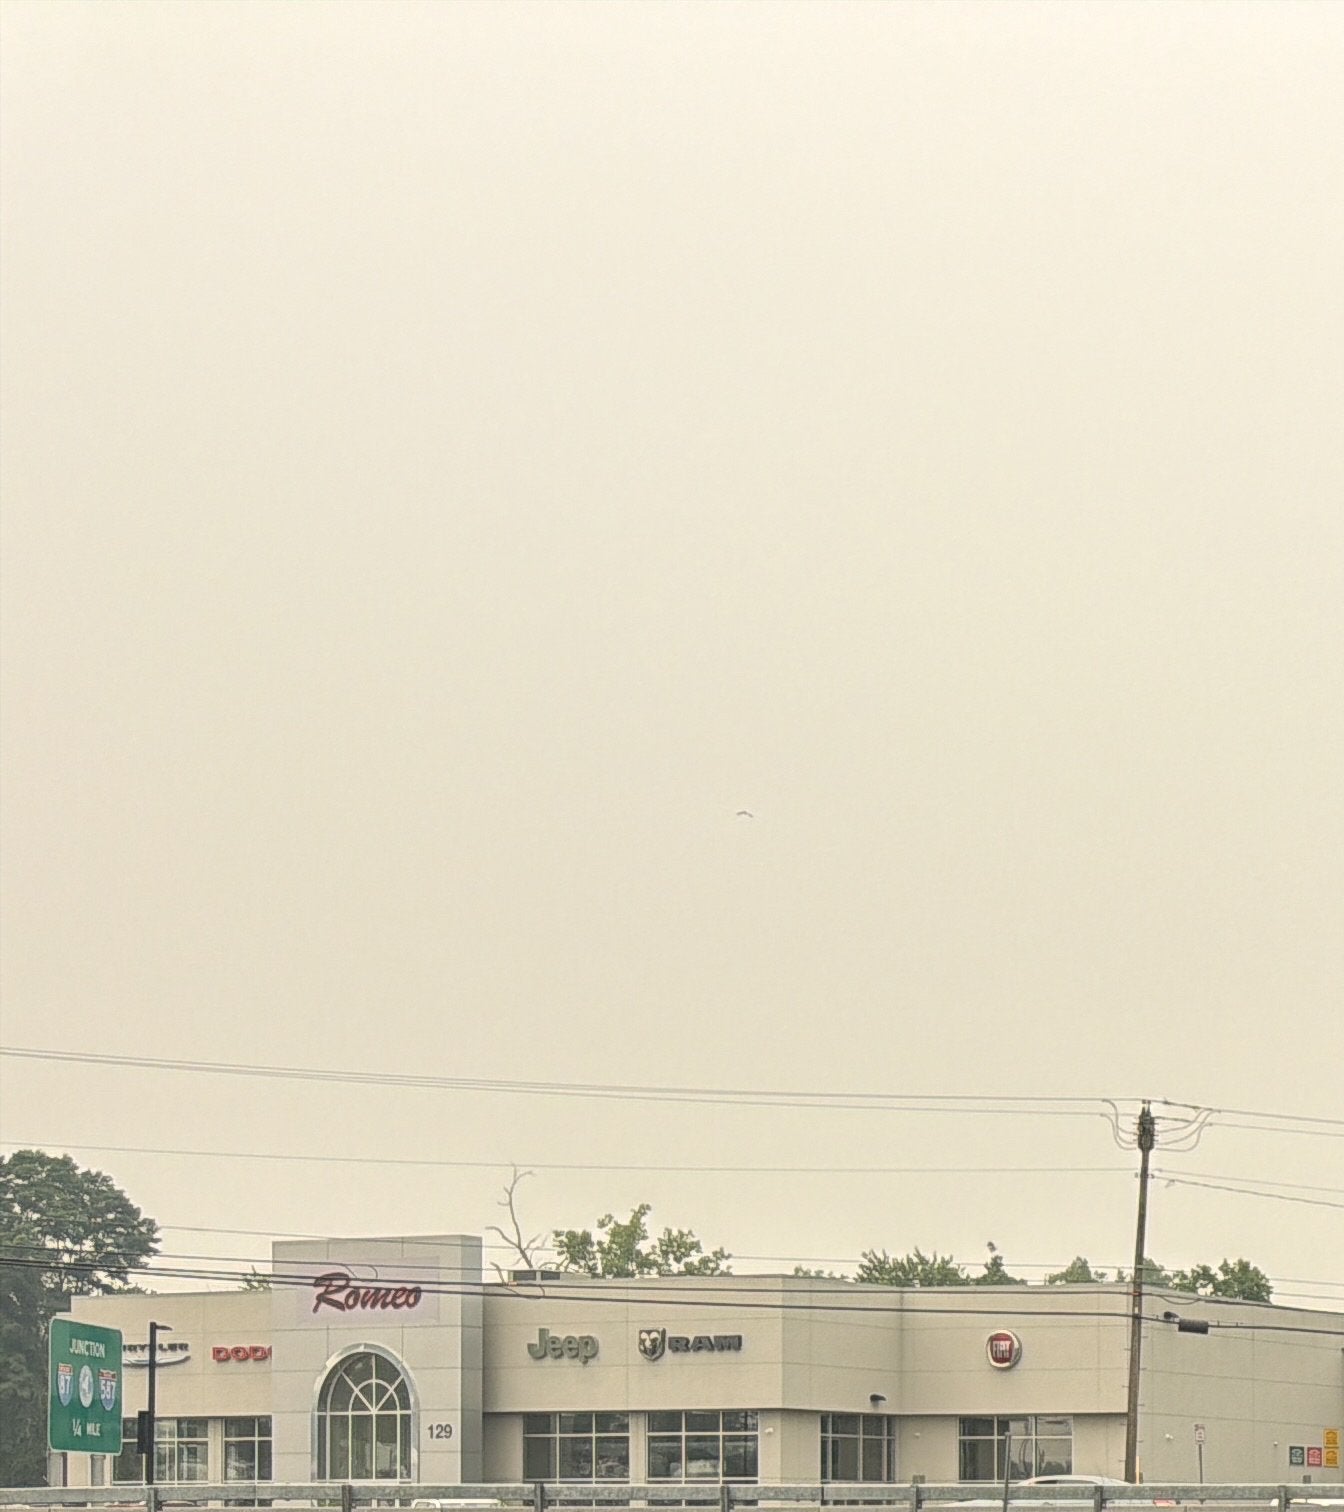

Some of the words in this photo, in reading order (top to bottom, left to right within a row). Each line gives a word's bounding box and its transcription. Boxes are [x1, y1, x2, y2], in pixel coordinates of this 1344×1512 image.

[312, 1272, 422, 1314] Romeo
[69, 1338, 106, 1359] JUNCTION
[527, 1327, 600, 1366] Jeep
[667, 1334, 743, 1353] RAM
[427, 1423, 453, 1440] 129
